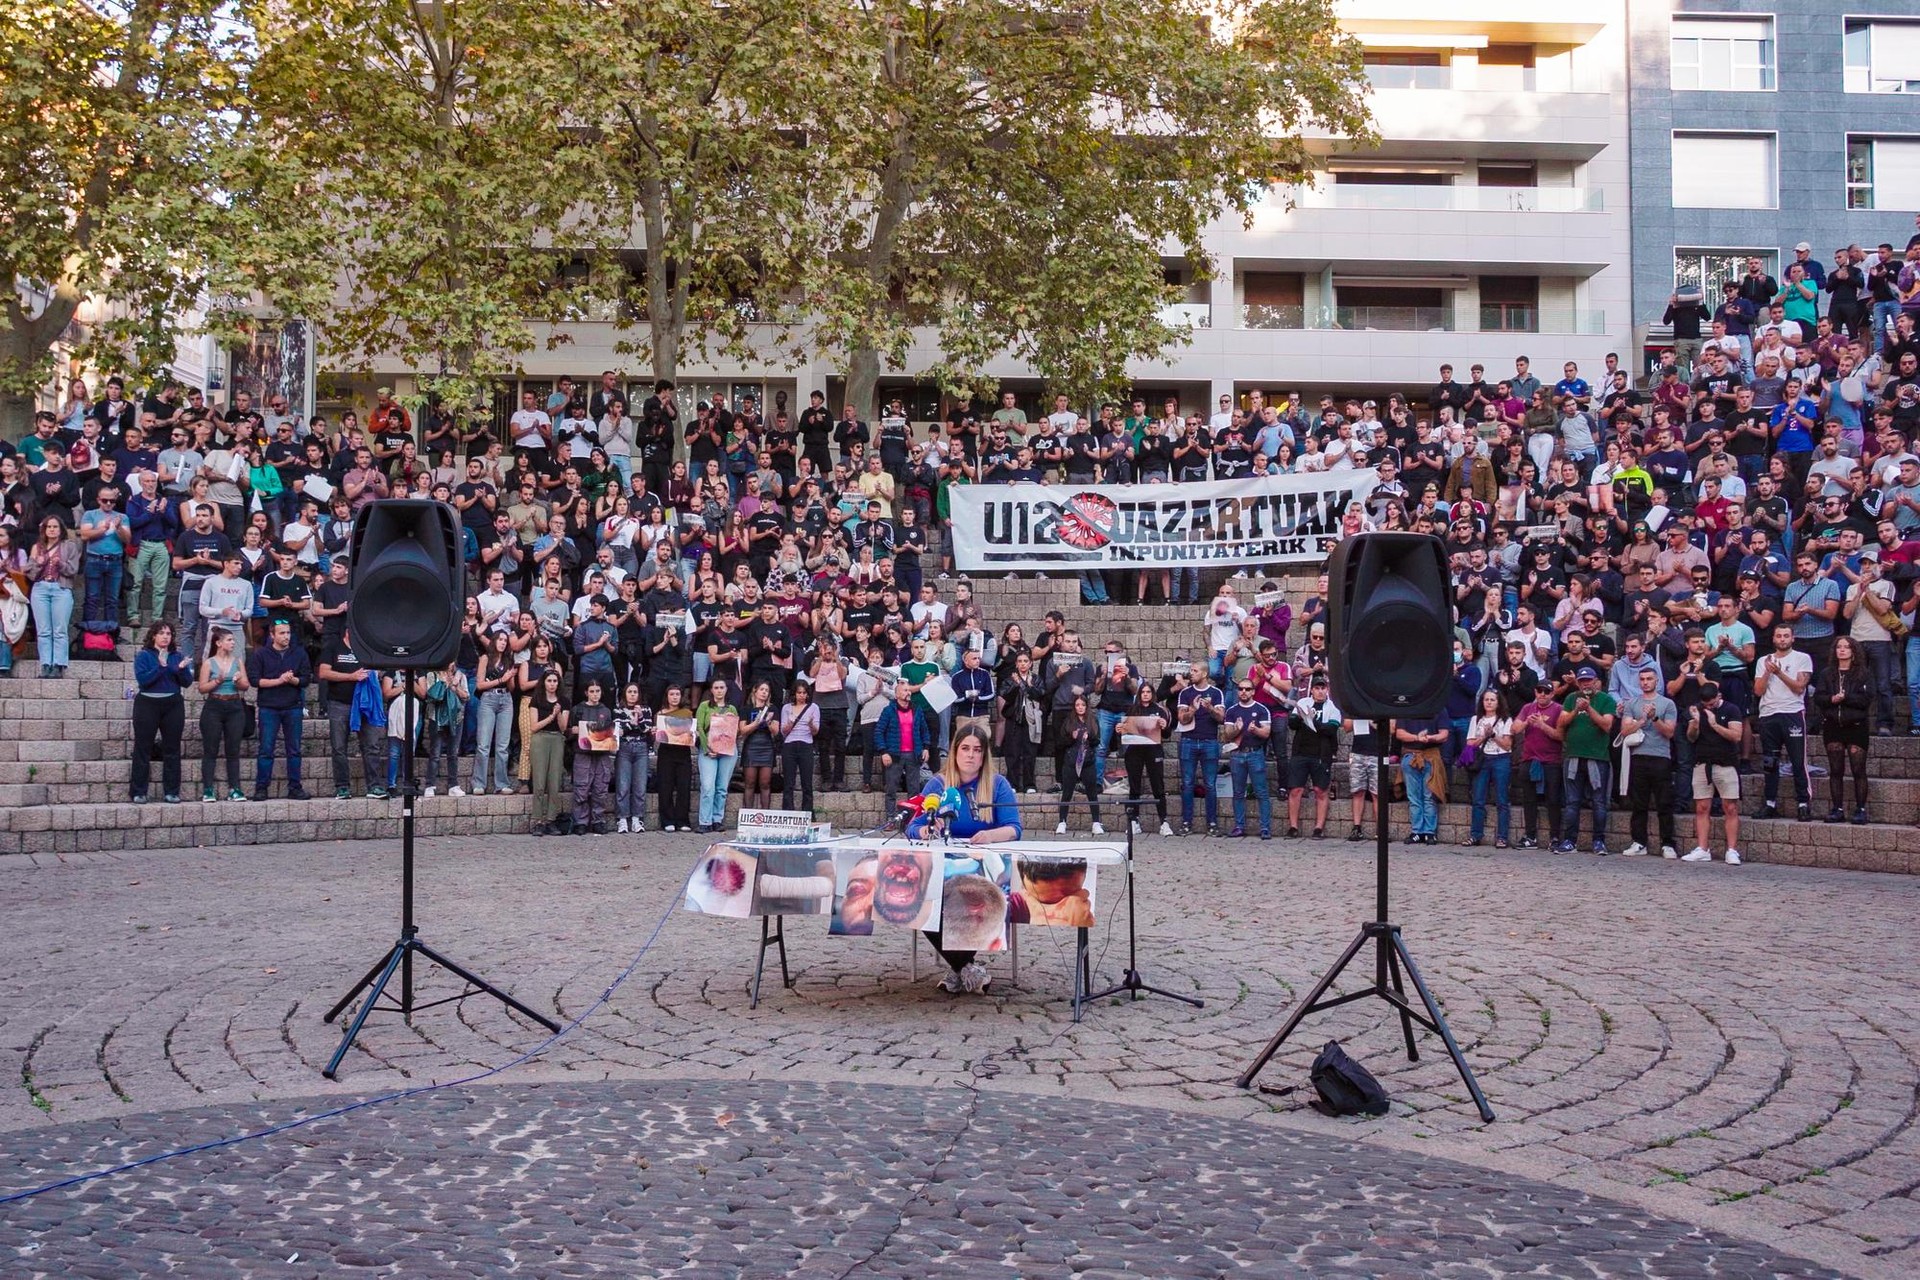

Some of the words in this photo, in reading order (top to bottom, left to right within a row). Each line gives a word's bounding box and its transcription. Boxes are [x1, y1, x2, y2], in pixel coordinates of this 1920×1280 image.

[984, 501, 1060, 544] U12
[1112, 490, 1352, 543] JAZARTUAK
[1110, 538, 1306, 561] INPUNITATERIK
